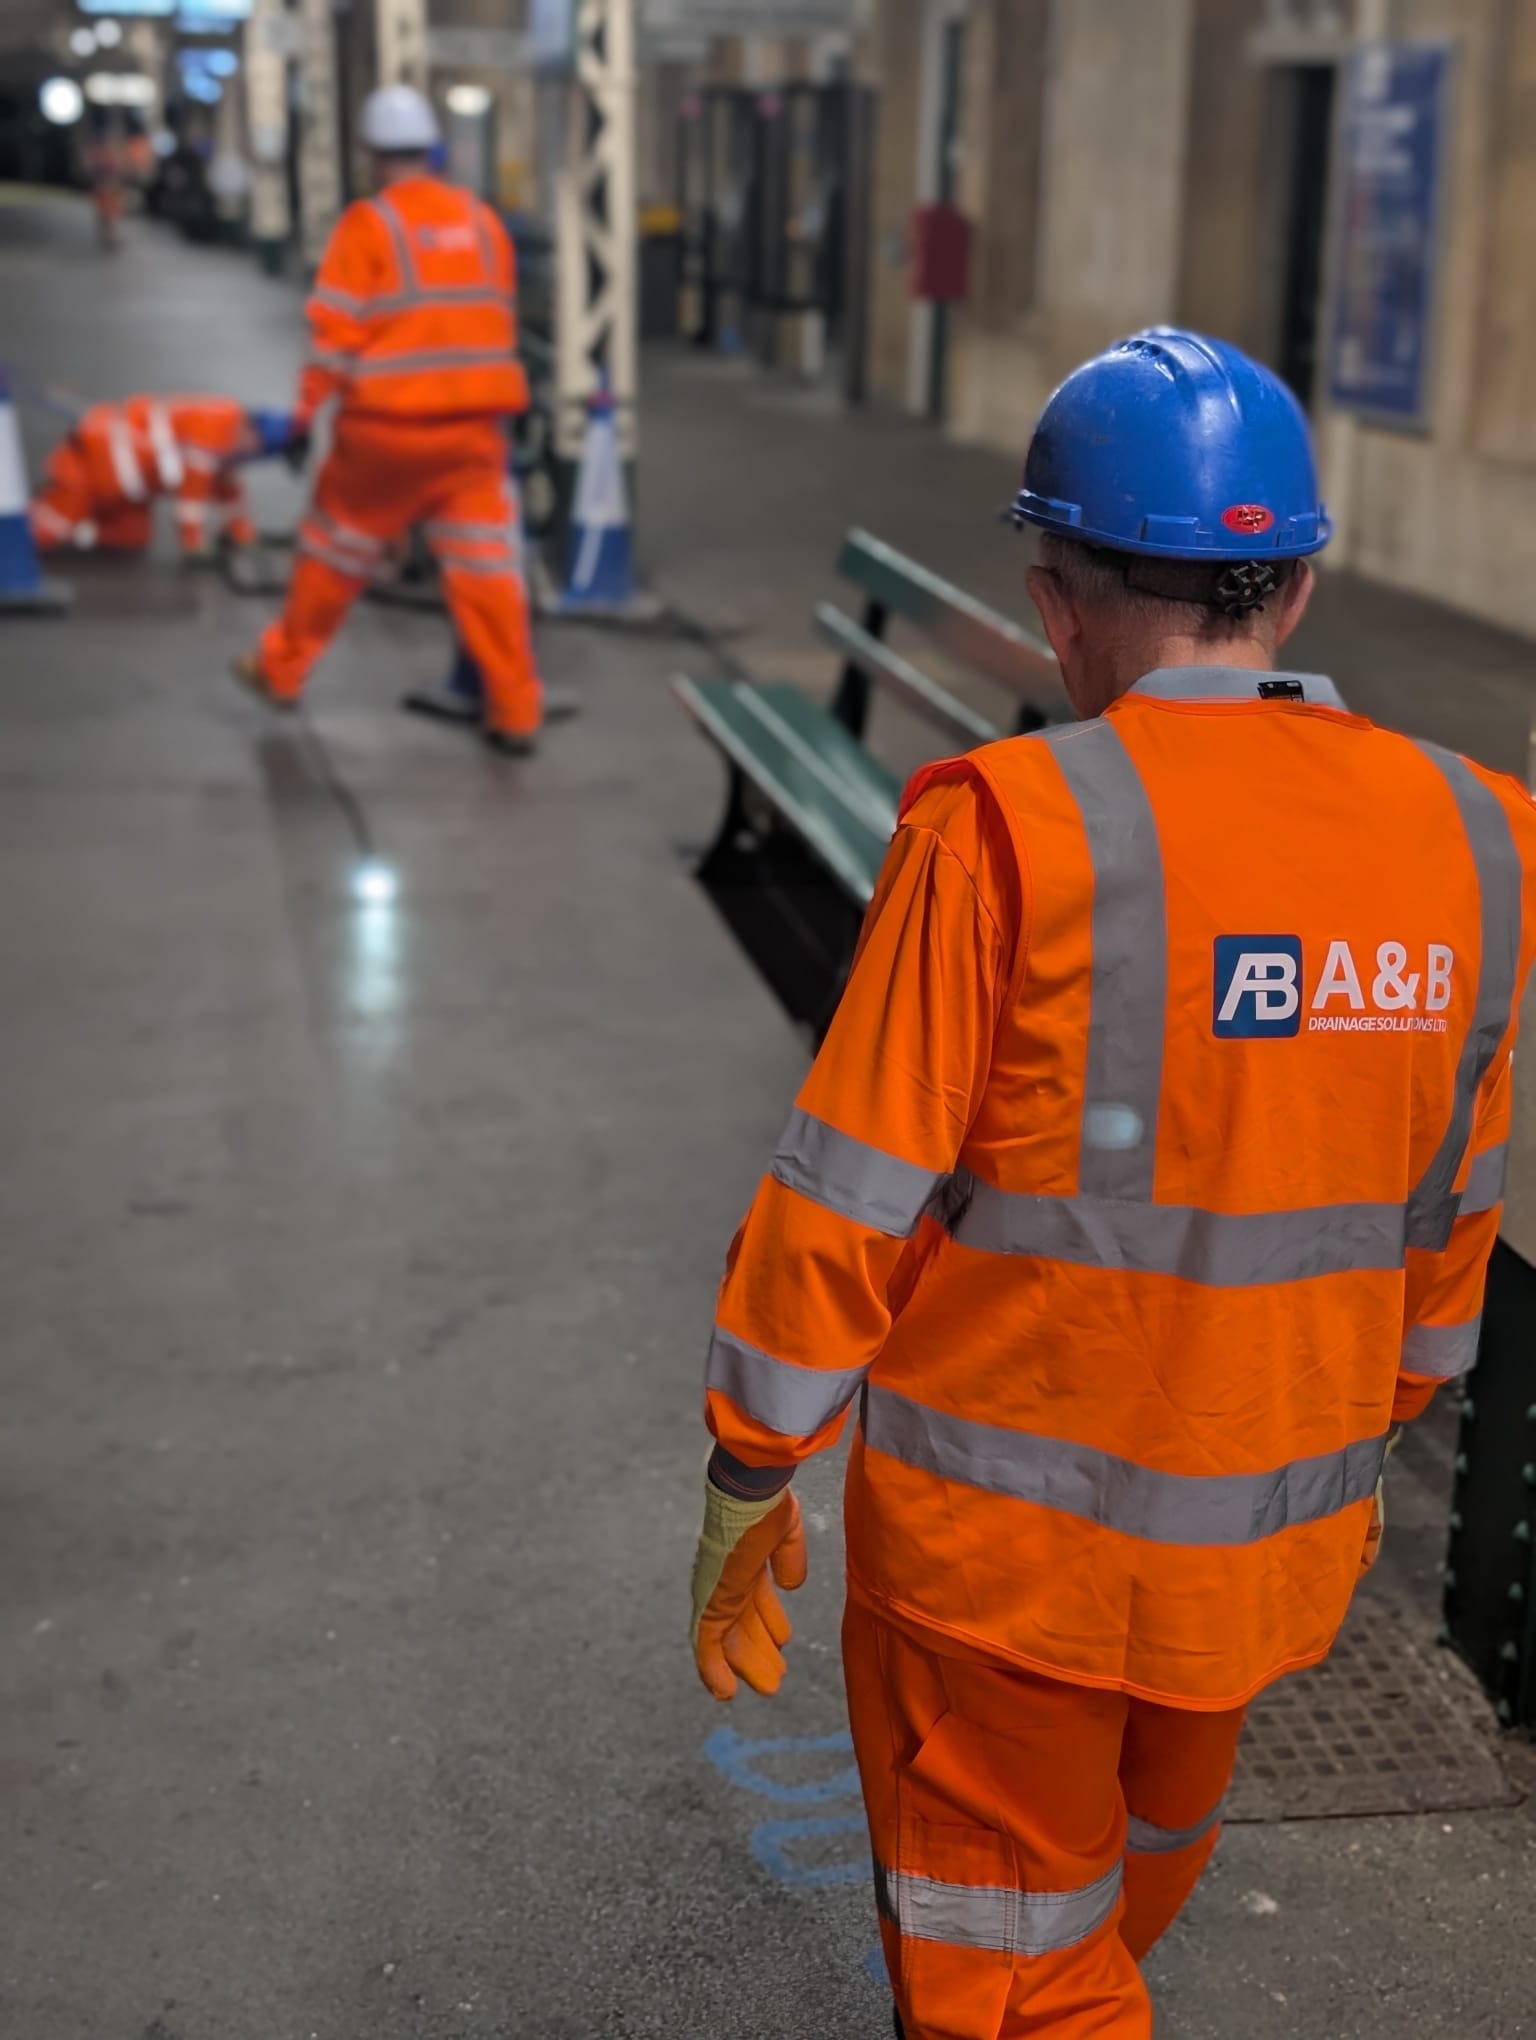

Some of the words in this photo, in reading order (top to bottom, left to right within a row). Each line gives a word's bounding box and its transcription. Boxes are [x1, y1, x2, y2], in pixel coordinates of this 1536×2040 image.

[1311, 941, 1365, 1009] A
[1372, 941, 1420, 1010] &
[1425, 944, 1454, 1010] B
[1308, 1016, 1376, 1031] DRAINAGE
